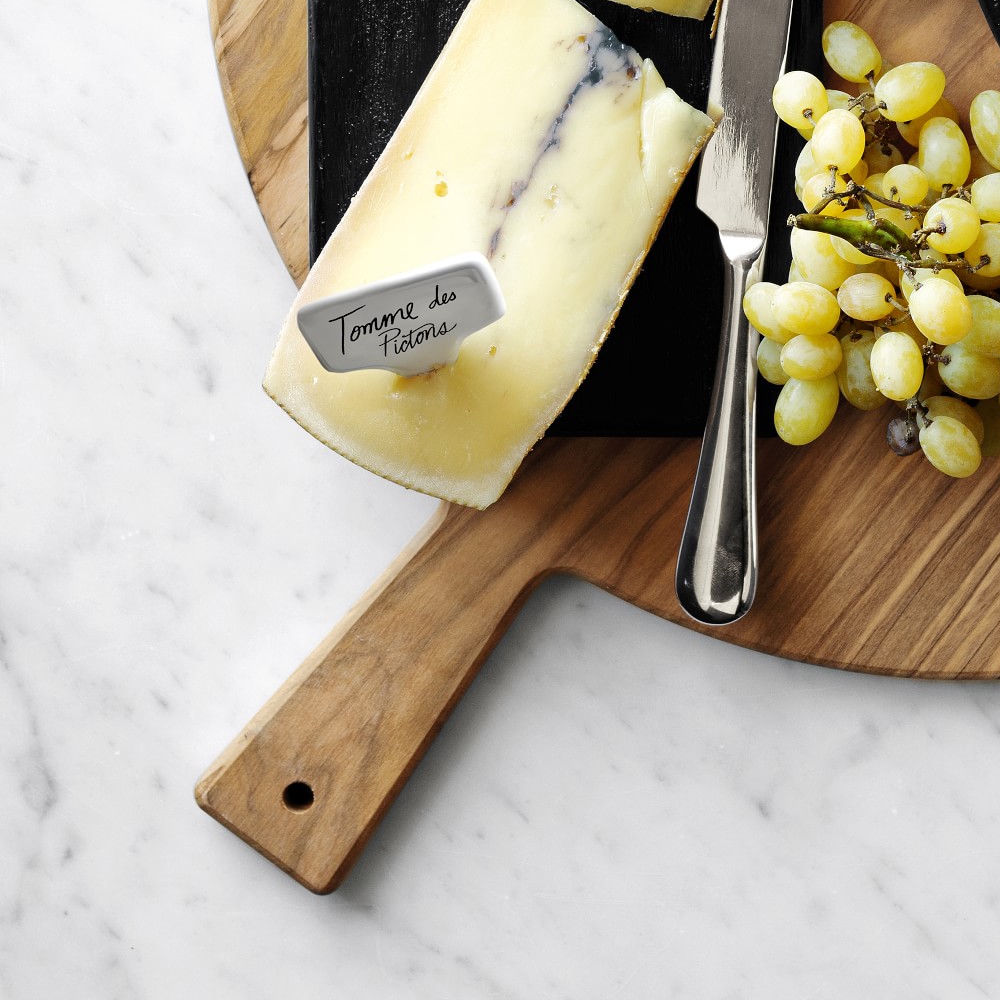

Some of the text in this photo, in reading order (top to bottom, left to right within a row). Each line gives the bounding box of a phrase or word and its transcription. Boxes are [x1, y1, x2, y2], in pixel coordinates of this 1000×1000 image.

[328, 284, 458, 355] Tomme des
[377, 321, 458, 358] Pictons
